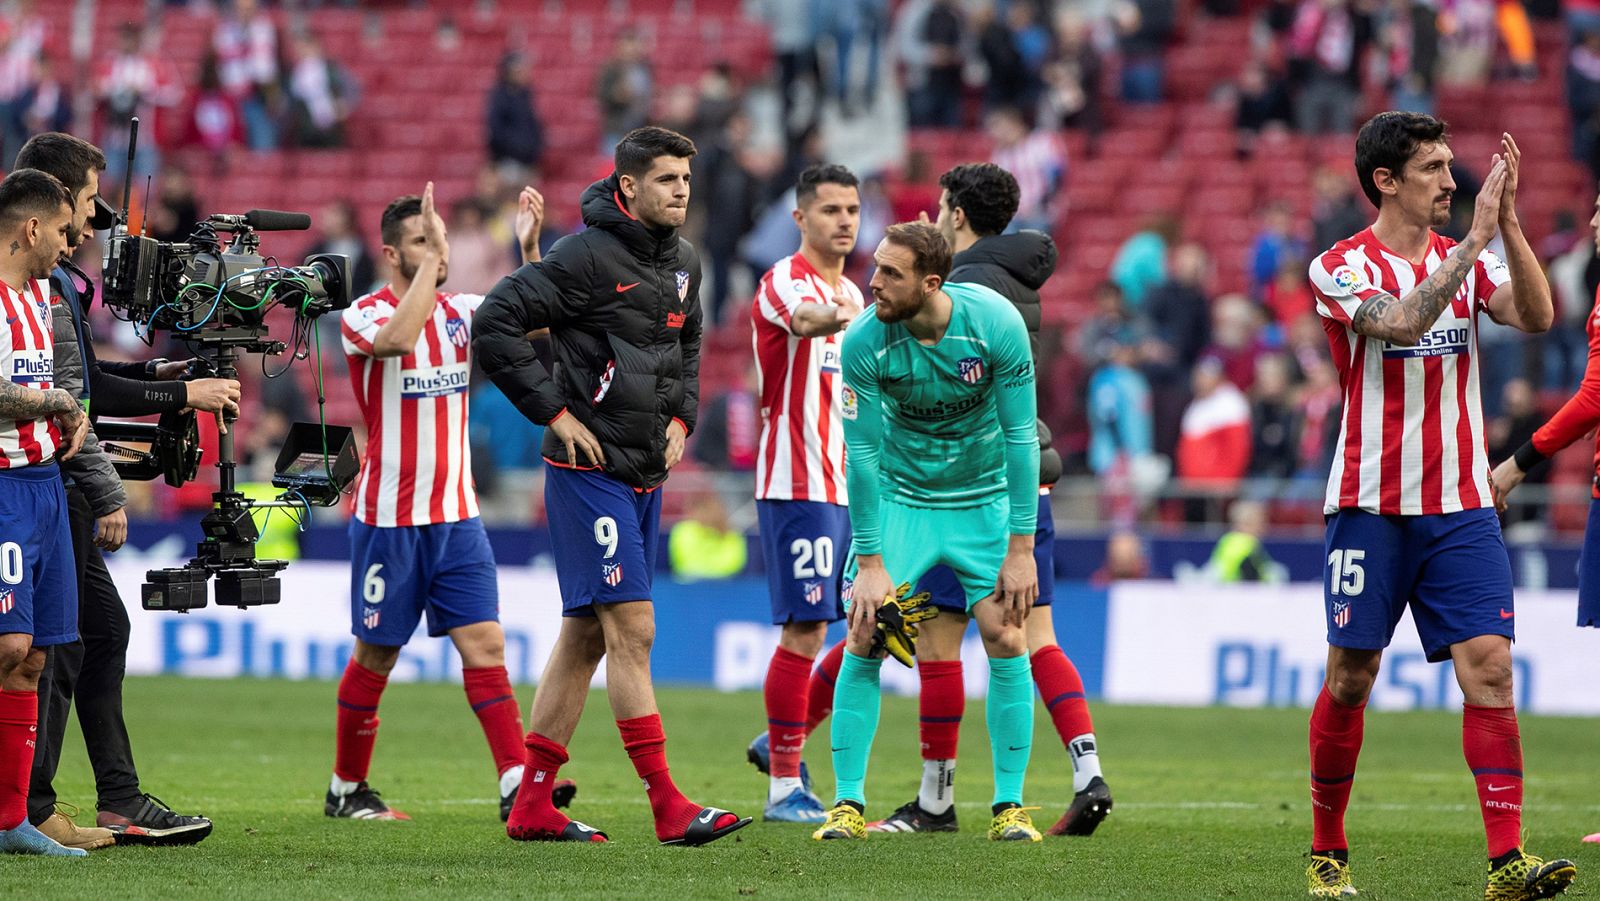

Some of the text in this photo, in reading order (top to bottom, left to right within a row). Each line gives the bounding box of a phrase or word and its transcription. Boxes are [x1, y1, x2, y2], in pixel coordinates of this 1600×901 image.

[1386, 328, 1468, 348] s500
[824, 350, 842, 363] Pl
[1431, 347, 1453, 355] Online
[403, 371, 467, 391] Plus500
[144, 390, 174, 401] KIPSTA
[594, 516, 618, 559] 9
[791, 536, 833, 579] 20
[1328, 549, 1365, 596] 15
[363, 563, 386, 604] 6
